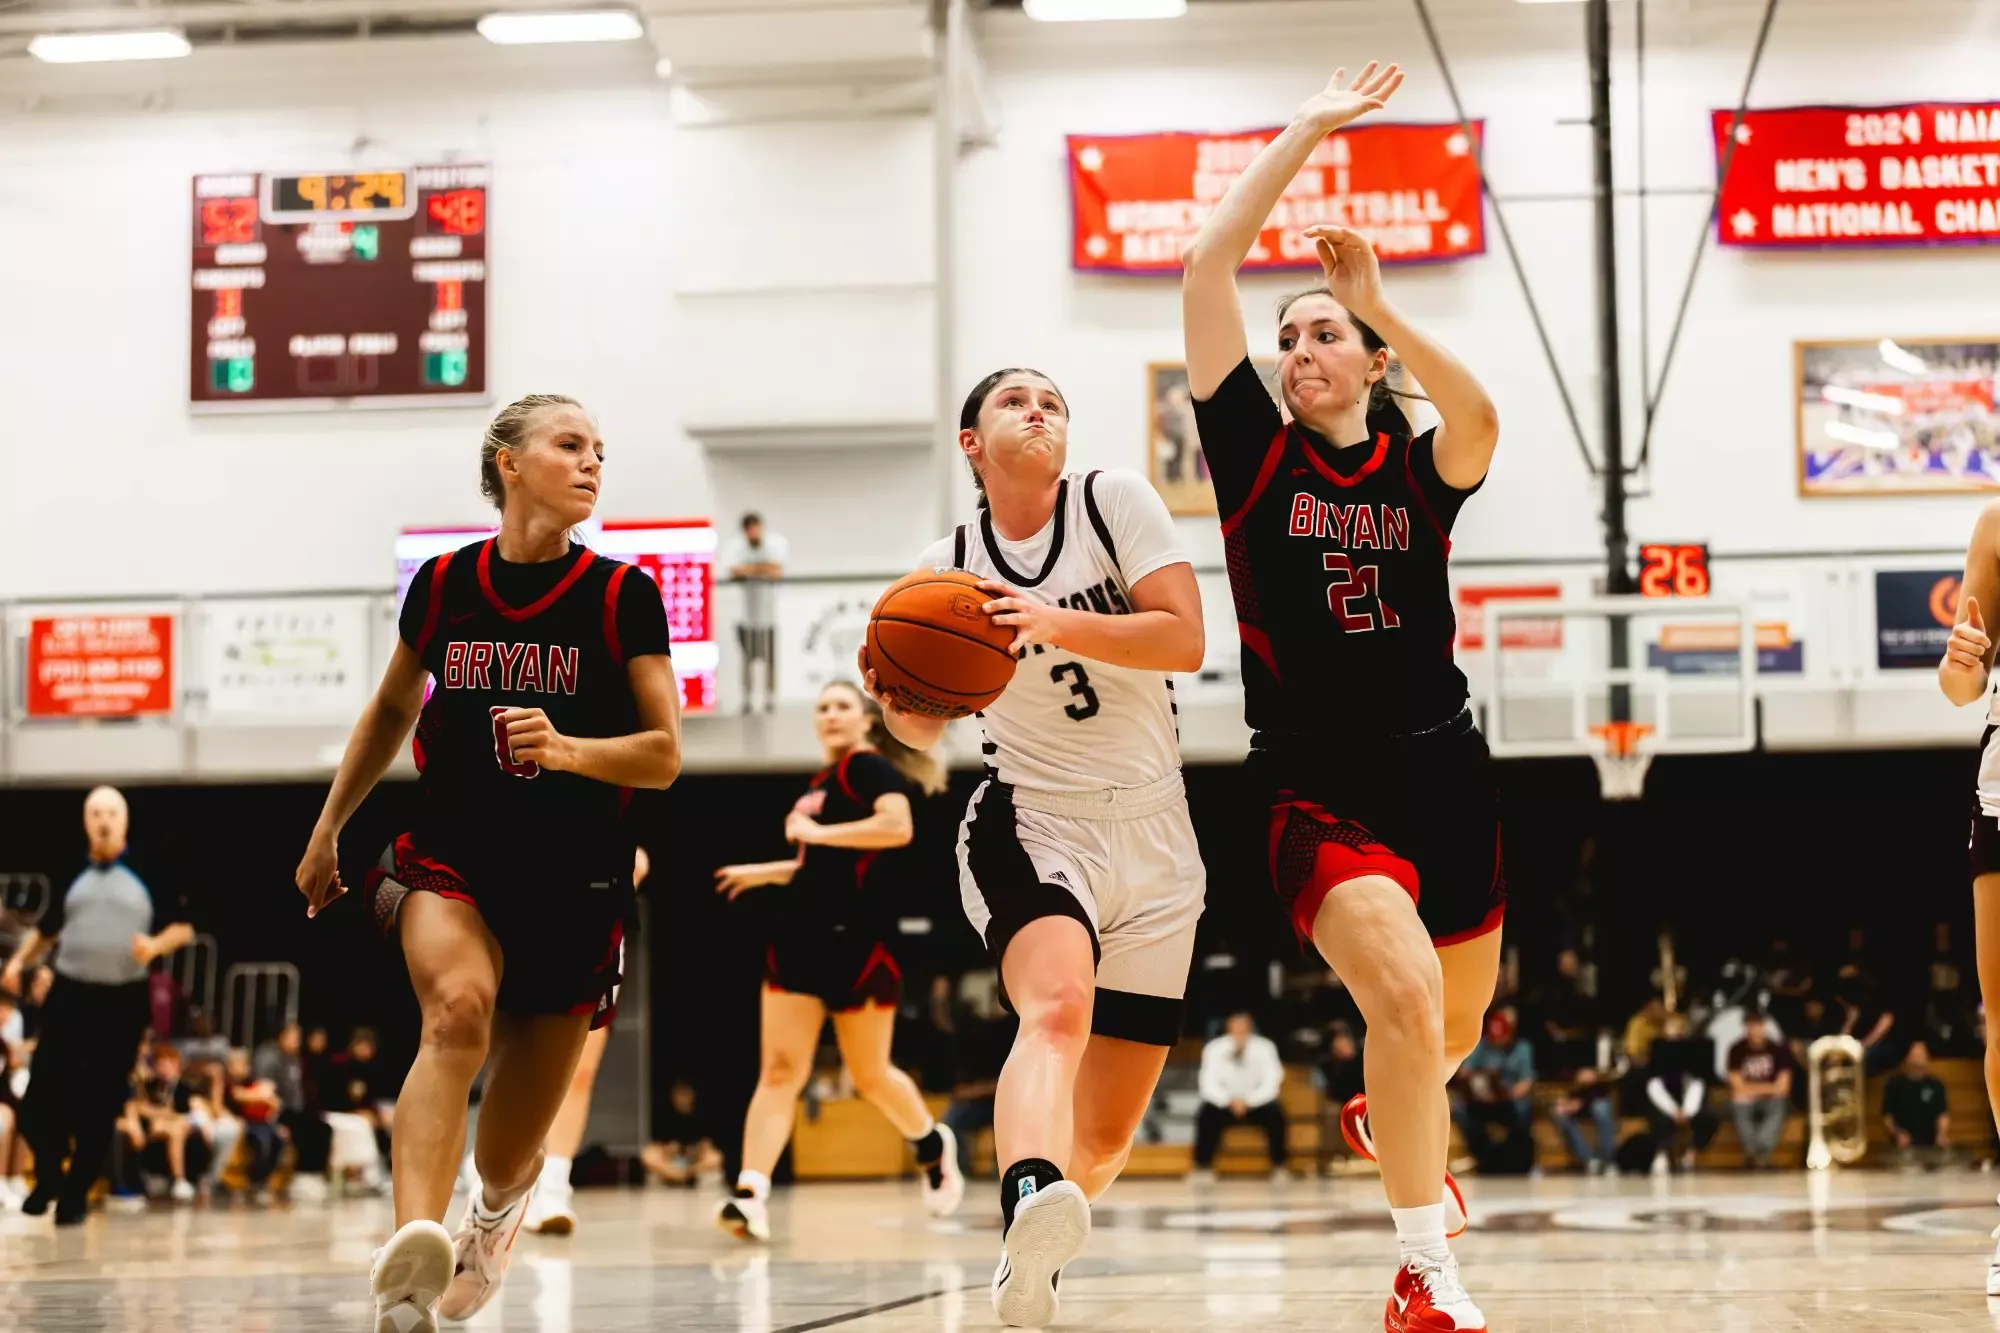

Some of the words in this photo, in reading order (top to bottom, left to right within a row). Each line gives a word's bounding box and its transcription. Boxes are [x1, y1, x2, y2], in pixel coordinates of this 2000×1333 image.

[1846, 113, 1921, 146] 2024
[1775, 159, 1867, 191] MEN'S
[1772, 202, 1923, 237] NATIONAL
[1935, 199, 2000, 232] CHA
[1289, 492, 1410, 550] BRYAN
[1322, 552, 1401, 633] 21
[1640, 544, 1710, 598] 26
[444, 641, 579, 695] BRYAN
[1050, 661, 1100, 722] 3
